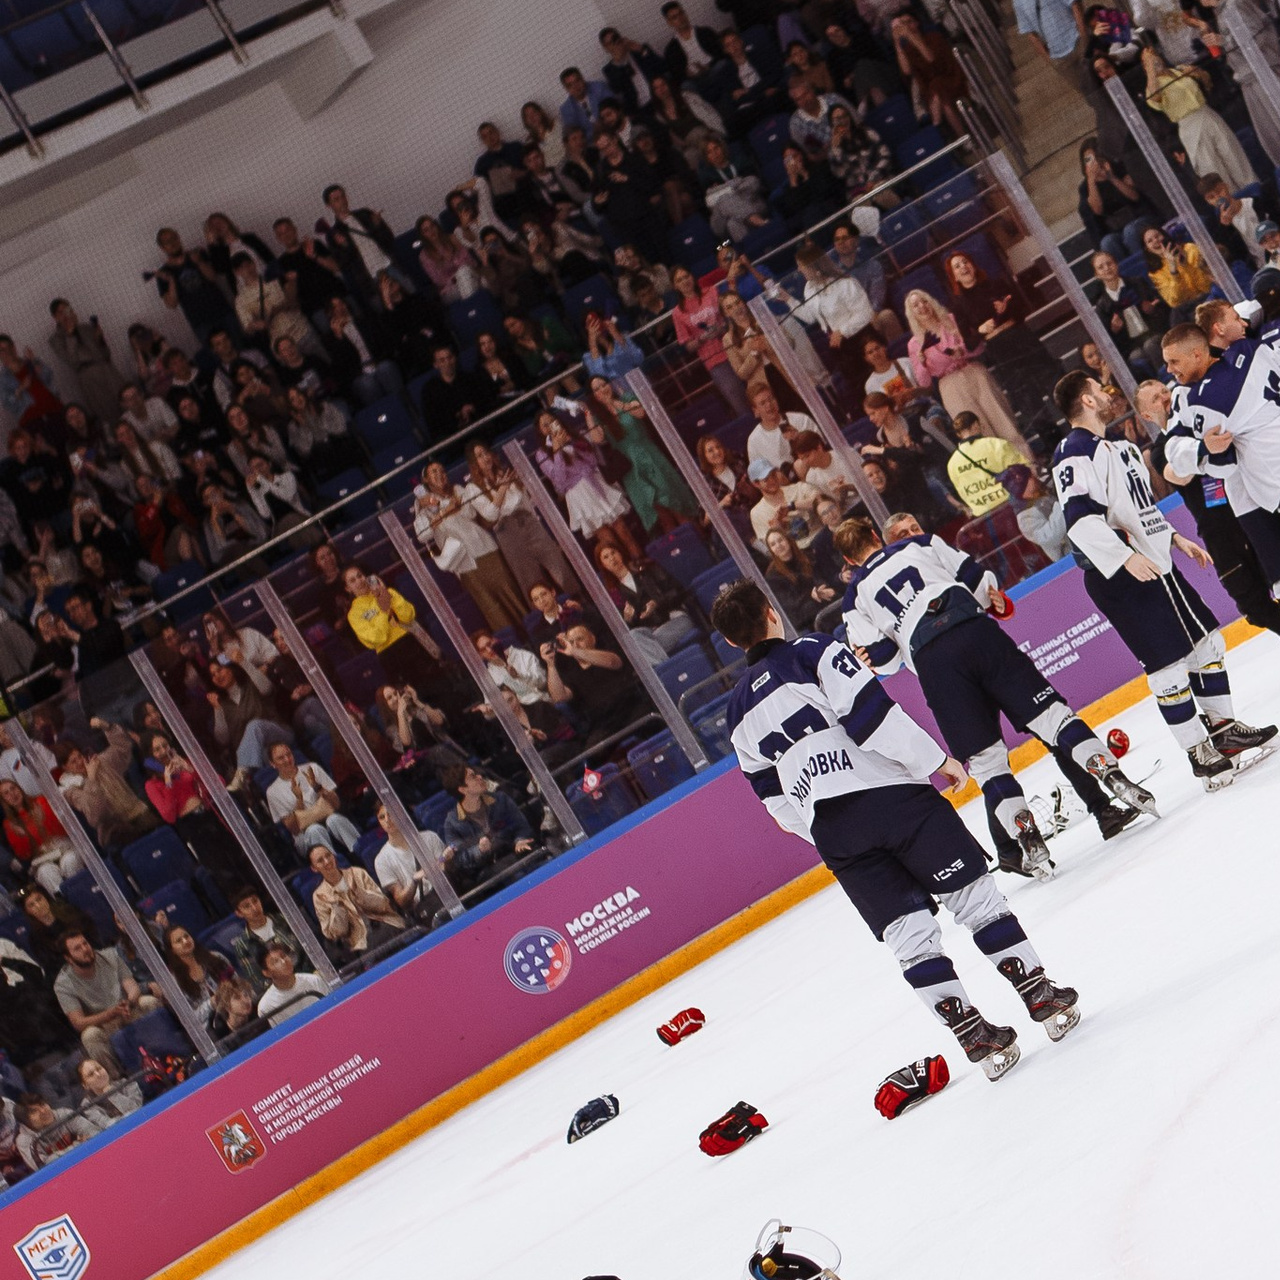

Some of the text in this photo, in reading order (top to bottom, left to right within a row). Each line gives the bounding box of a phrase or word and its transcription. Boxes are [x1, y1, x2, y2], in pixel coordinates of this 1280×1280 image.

[873, 564, 927, 621] 17
[1066, 612, 1101, 639] СВЯЗЕЙ
[1070, 618, 1113, 650] ПОЛИТИК
[831, 647, 863, 680] 27
[1041, 651, 1081, 679] МОСКВЫ
[564, 885, 641, 938] МОСКВА
[573, 906, 635, 948] МОЛОДЁЖНАЯ
[578, 906, 651, 955] СТОЛИЦА РОССИИ
[252, 1082, 294, 1115] КОМИТЕТ
[257, 1053, 364, 1125] ОБЩЕСТВЕННЫХ СВЯЗЕЙ
[264, 1056, 382, 1135] И МОЛОДЁЖНОЙ ПОЛИТИКИ
[270, 1094, 344, 1146] ГОРОДА МОСКВЫ
